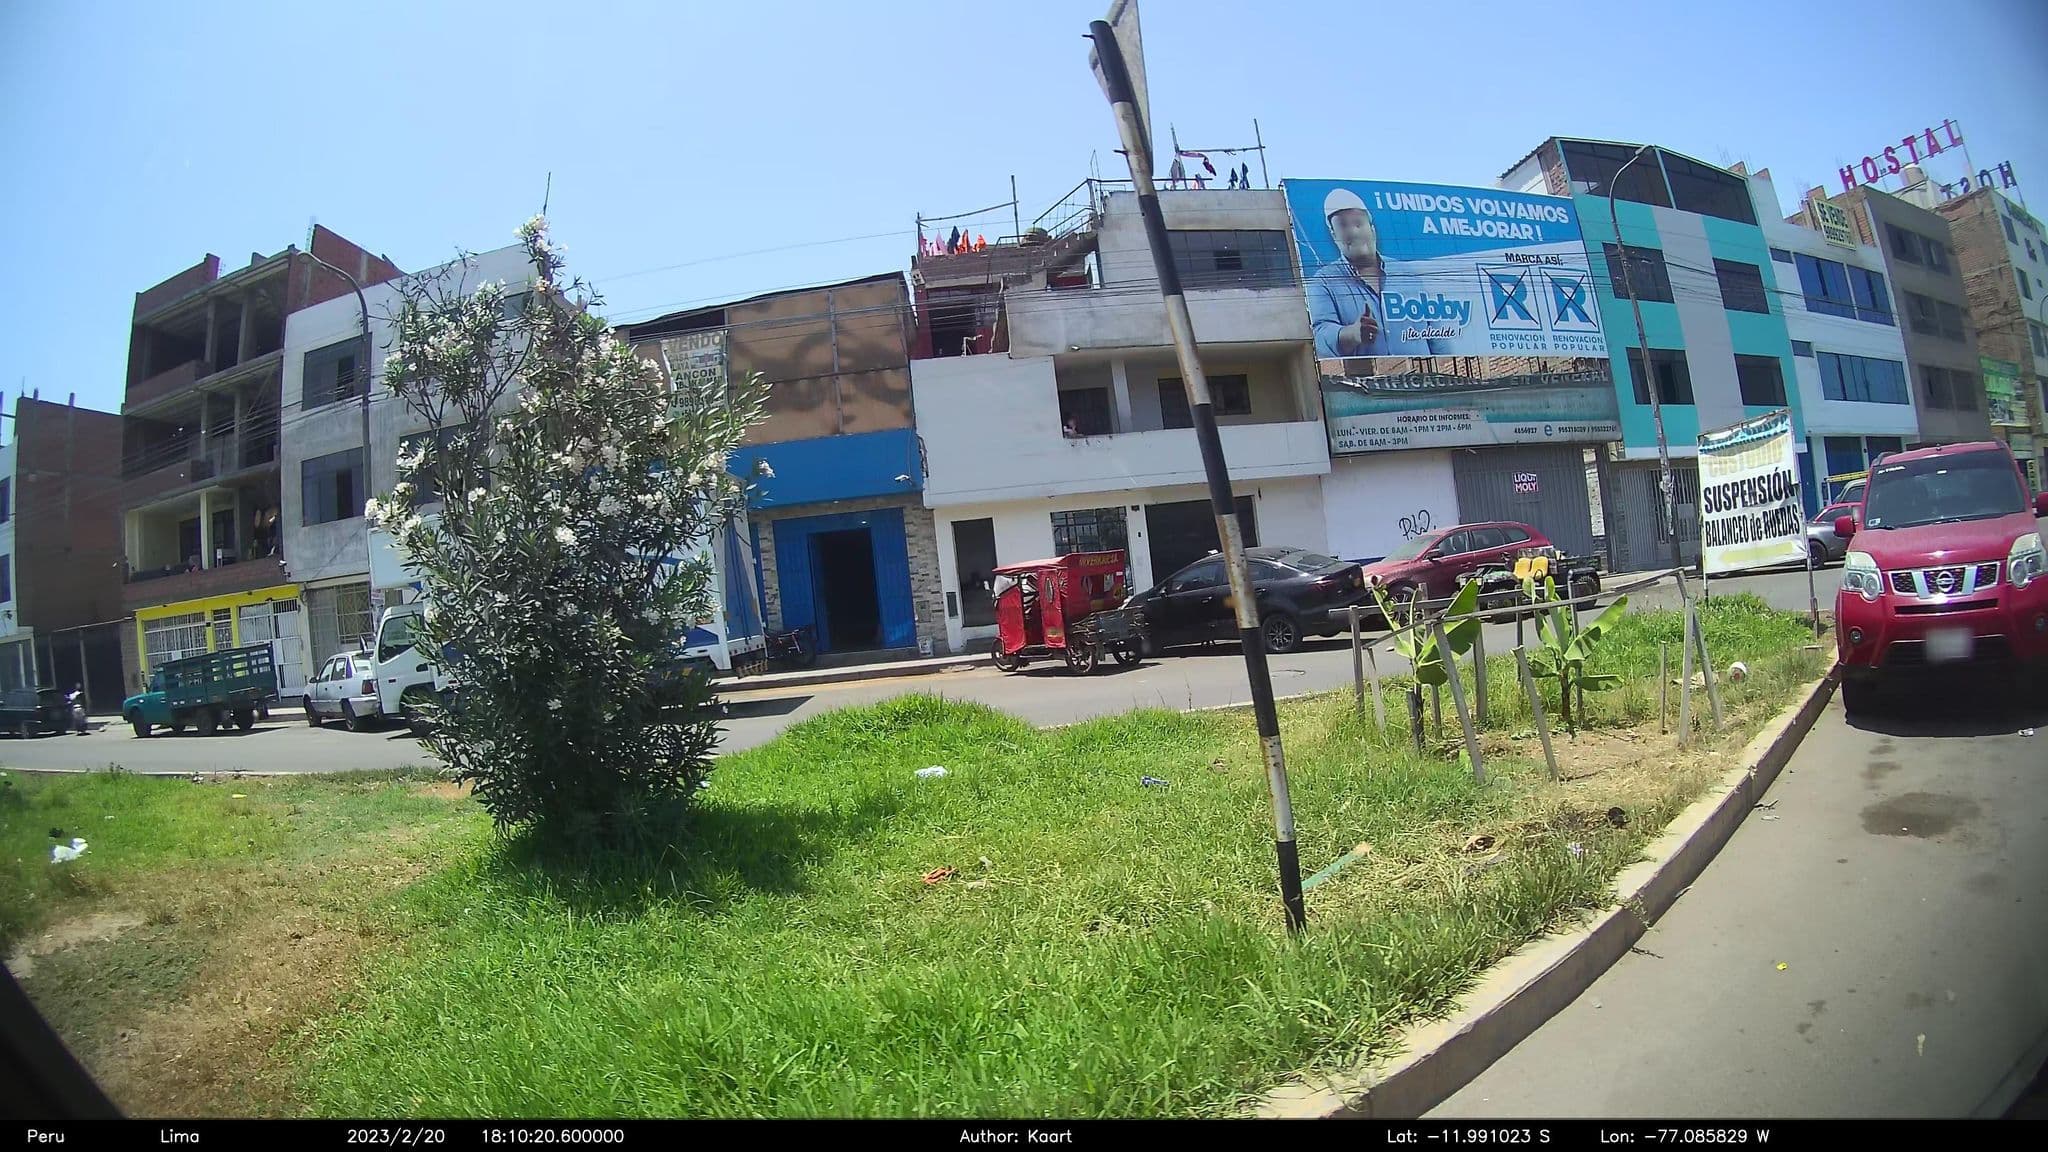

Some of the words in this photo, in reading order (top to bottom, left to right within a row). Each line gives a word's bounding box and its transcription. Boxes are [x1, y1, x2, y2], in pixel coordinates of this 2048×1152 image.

[1839, 119, 1964, 193] HOSTAL
[1385, 192, 1465, 214] UNIDOS
[1465, 197, 1570, 224] VOLVAMOS
[1422, 216, 1439, 234] A
[1440, 217, 1535, 241] MEJORAR
[1505, 253, 1543, 264] MARCA
[1382, 291, 1471, 327] Bobby
[1421, 326, 1456, 338] alcalde
[1491, 342, 1547, 350] POPULAR
[1554, 343, 1605, 352] POPULAR
[676, 368, 716, 380] ANCON
[1359, 427, 1379, 436] VIER.
[1380, 427, 1389, 435] DE
[1414, 425, 1428, 433] 1PM
[1436, 424, 1452, 432] 2PM
[1358, 439, 1368, 447] DE
[1515, 482, 1538, 492] MOLY
[1703, 467, 1795, 514] SUSPENSIÓN
[1705, 515, 1749, 548] BALANCEO
[1750, 513, 1763, 542] de
[1763, 503, 1800, 539] RUEDAS
